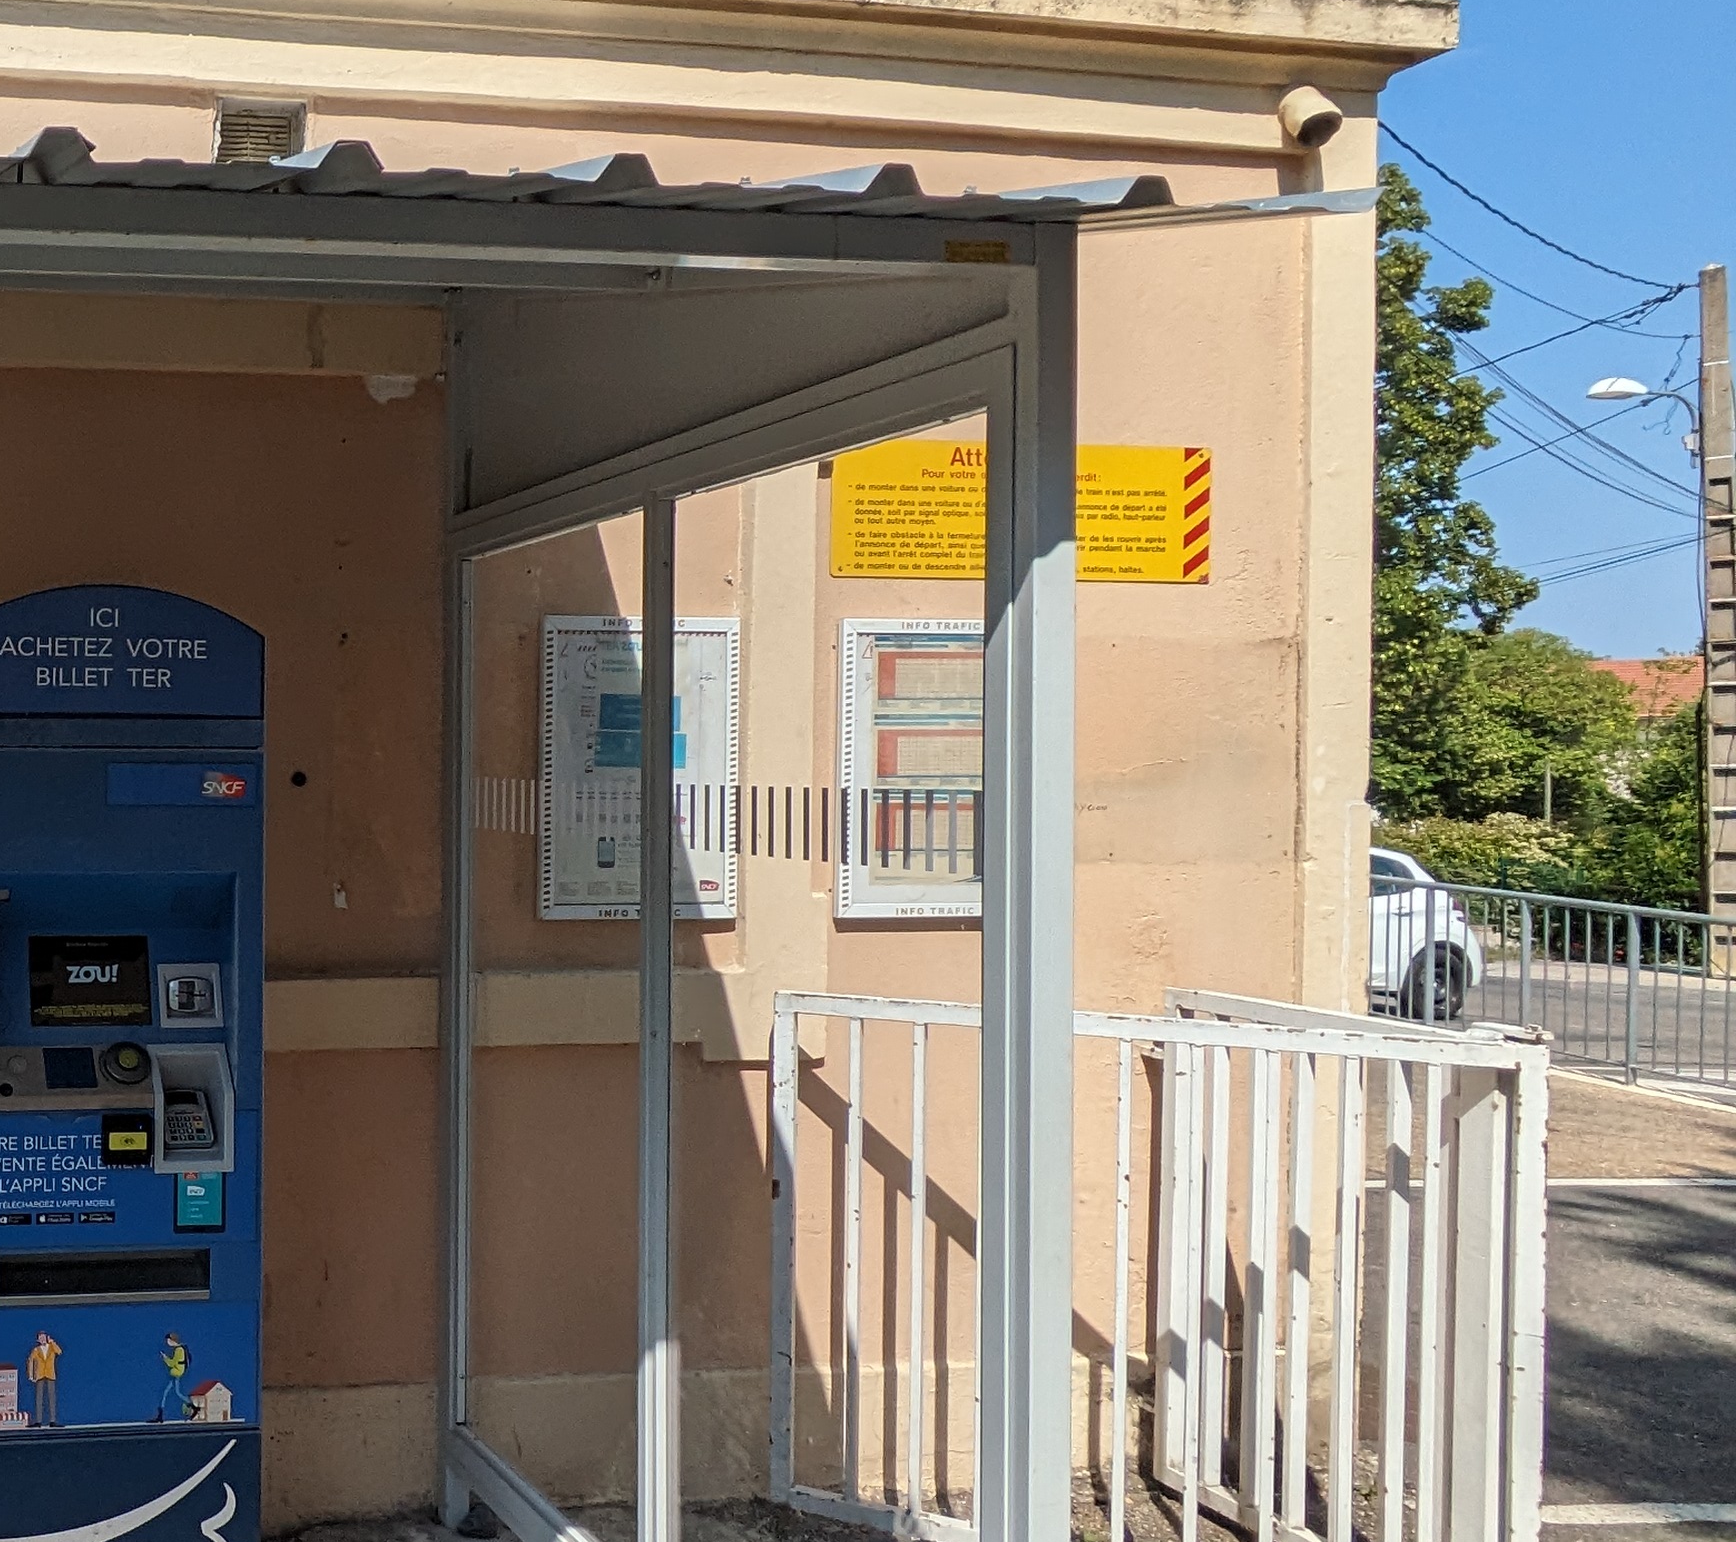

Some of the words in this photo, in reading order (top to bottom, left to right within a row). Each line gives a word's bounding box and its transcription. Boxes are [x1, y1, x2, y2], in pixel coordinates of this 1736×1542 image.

[921, 469, 945, 478] Pour
[950, 470, 976, 479] votre
[869, 483, 896, 491] monter
[903, 510, 916, 518] par
[919, 509, 940, 518] signal
[891, 531, 925, 539] obstacle
[919, 551, 952, 559] complet
[90, 607, 119, 628] ICI
[602, 618, 633, 627] INFO
[901, 621, 930, 630] INFO
[936, 621, 981, 630] TRAFIC
[0, 636, 113, 657] ACHETEZ
[126, 638, 207, 659] VOTRE
[36, 667, 114, 687] BILLET
[126, 667, 172, 688] TER
[202, 780, 246, 796] SNCF
[598, 909, 628, 917] INFO
[896, 907, 925, 916] INFO
[930, 907, 974, 916] TRAFIC
[66, 963, 119, 984] ZOU!
[23, 1135, 77, 1150] BILLET
[82, 1135, 103, 1149] TE
[51, 1153, 155, 1170] ÉGALE
[61, 1176, 107, 1192] SNCF
